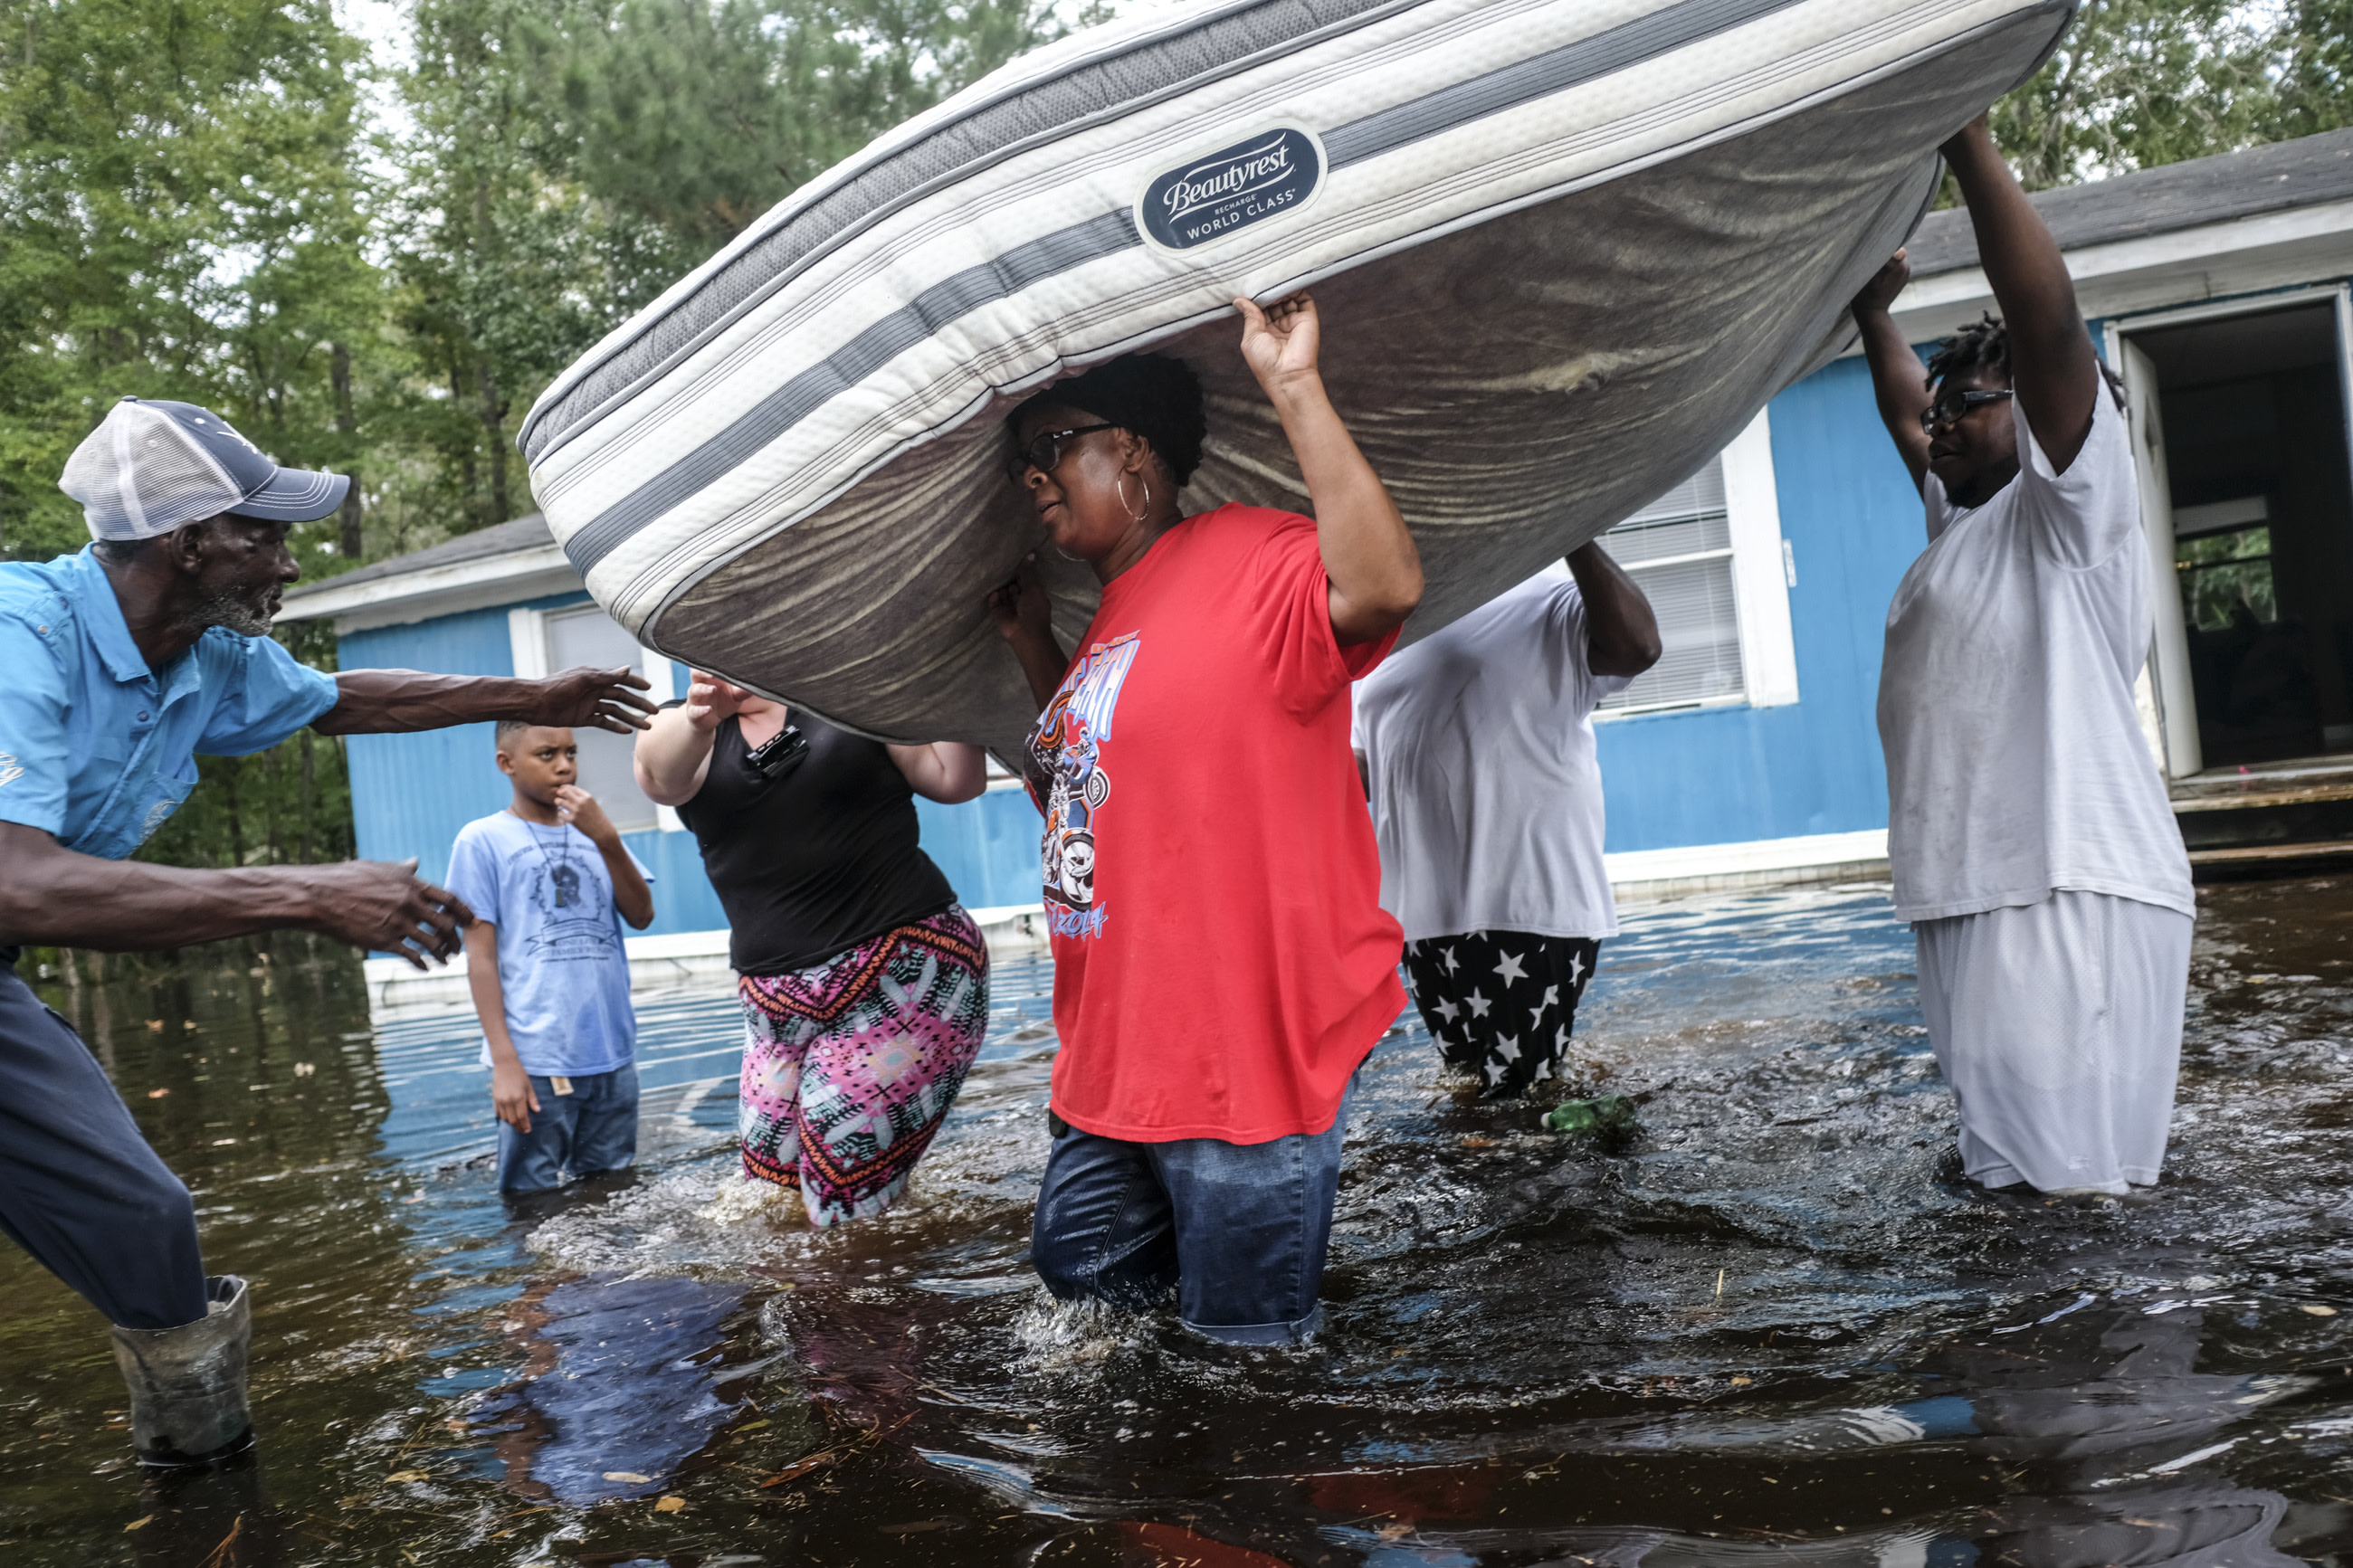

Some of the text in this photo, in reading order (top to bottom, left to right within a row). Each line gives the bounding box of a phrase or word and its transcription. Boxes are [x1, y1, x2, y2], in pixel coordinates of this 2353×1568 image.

[1163, 144, 1290, 216] Beautyrest
[1215, 194, 1256, 215] RECHARGE
[1187, 189, 1293, 240] WORLD CLASS
